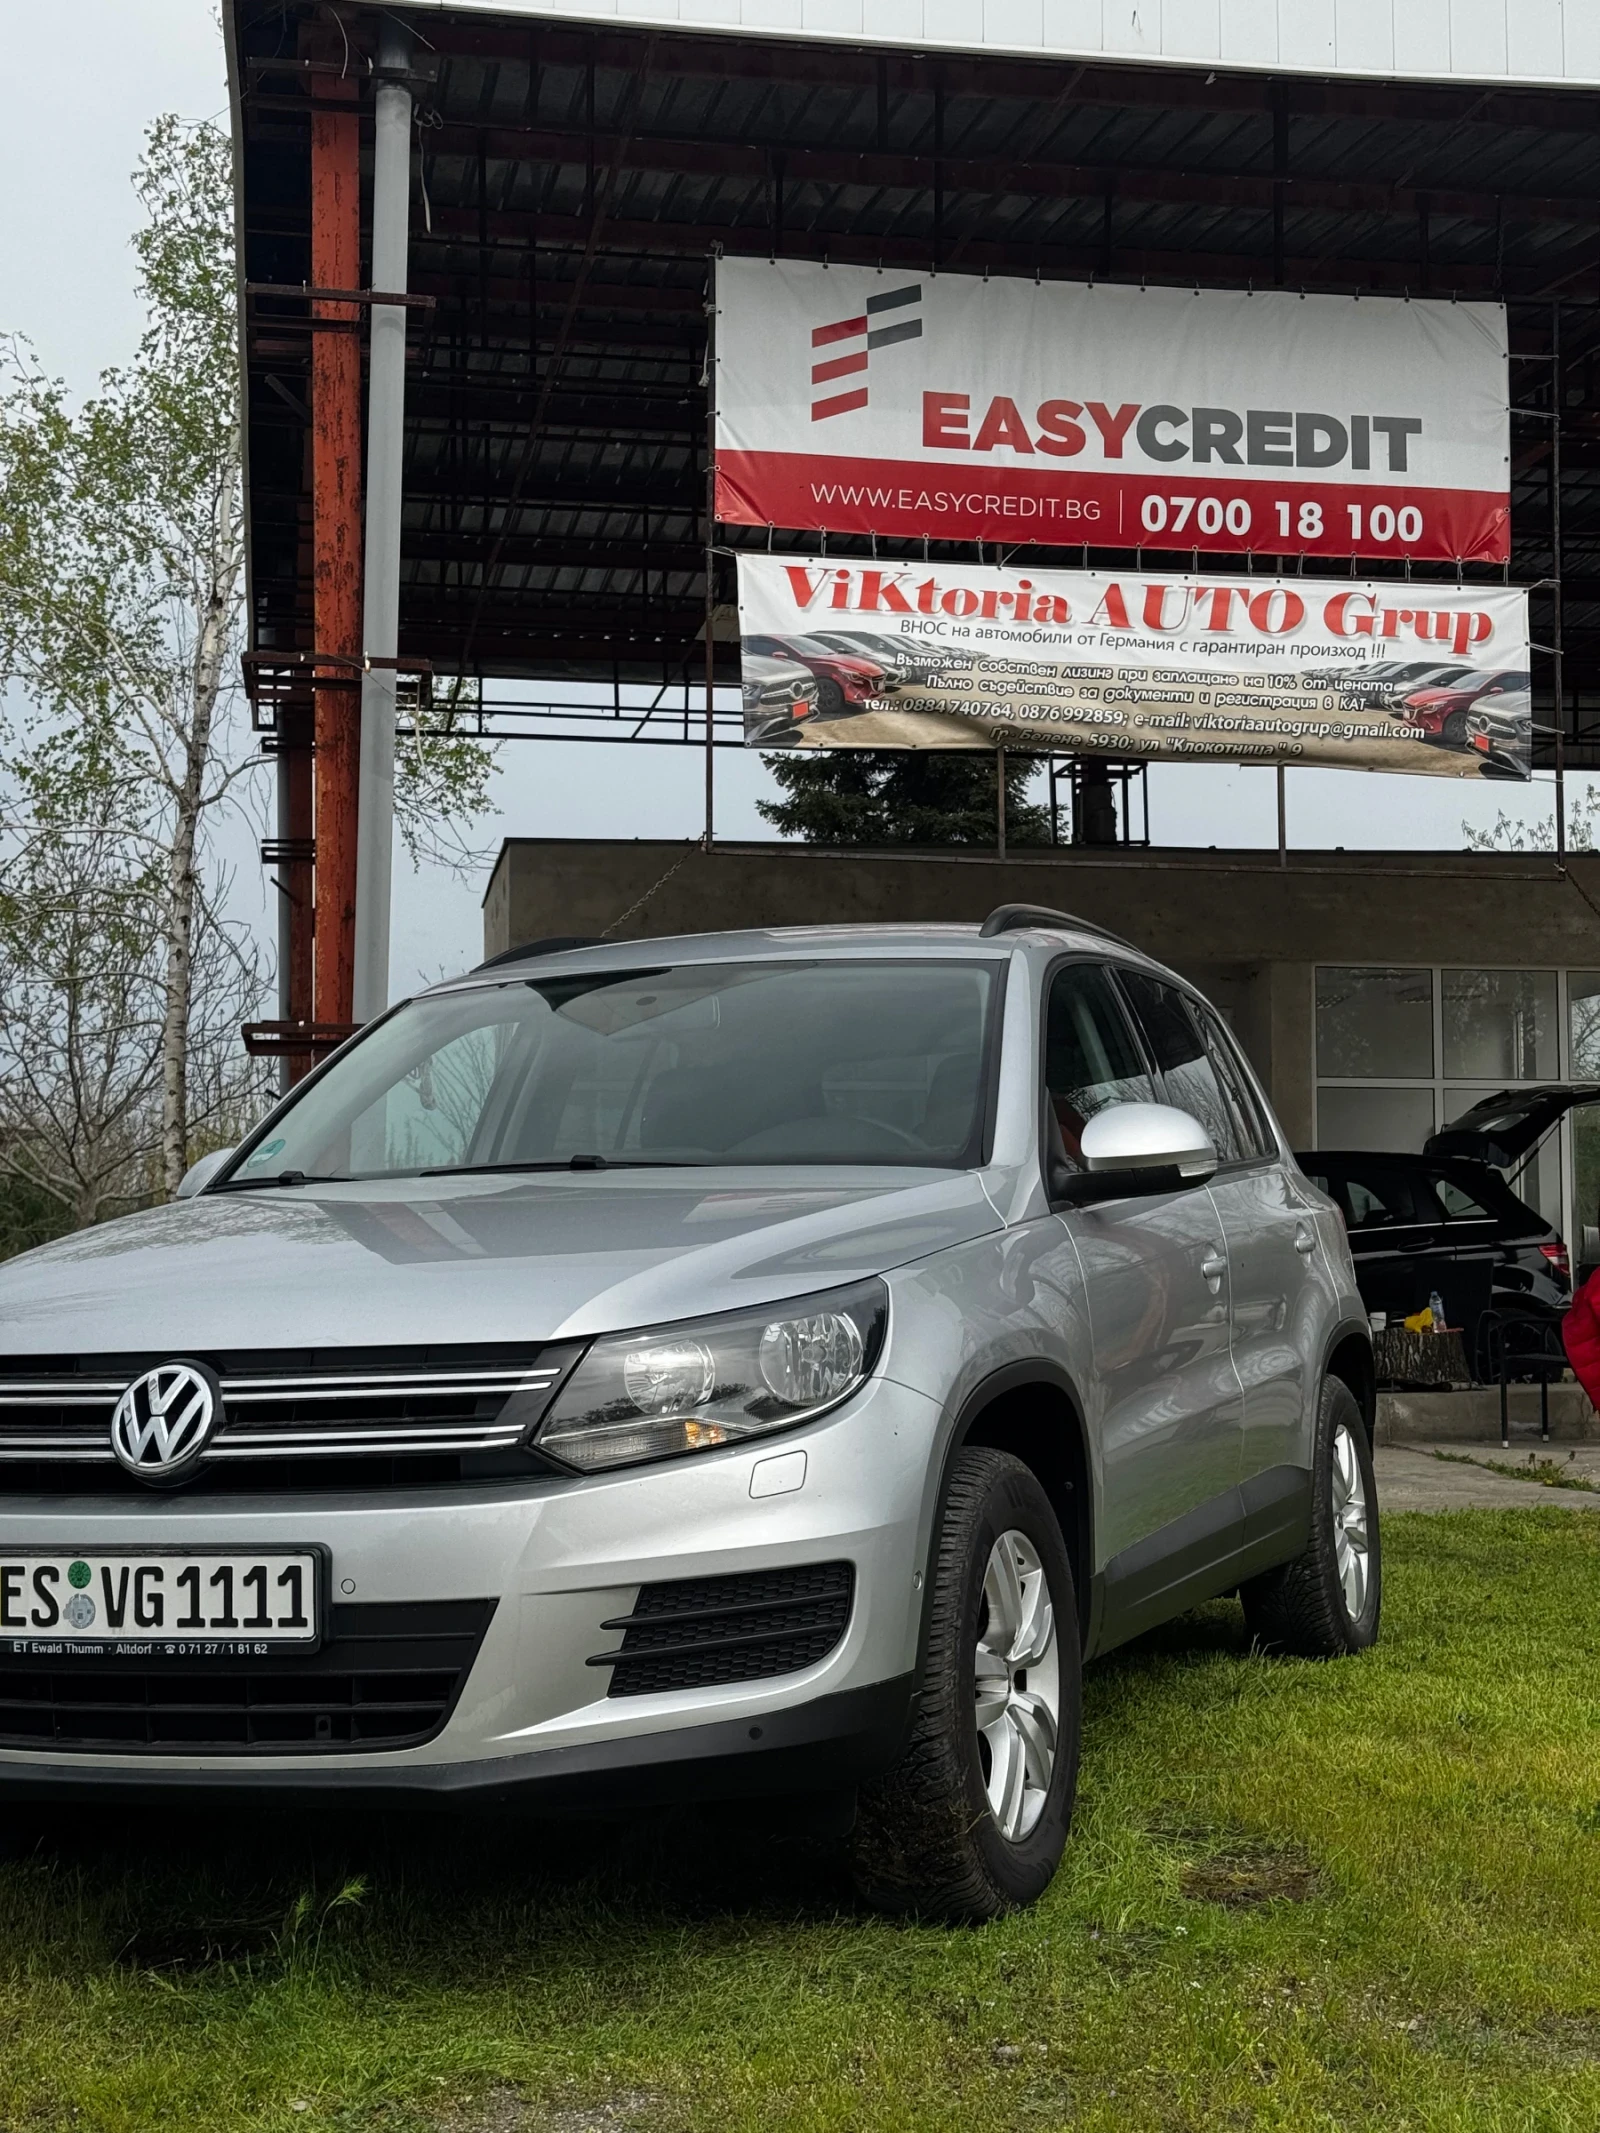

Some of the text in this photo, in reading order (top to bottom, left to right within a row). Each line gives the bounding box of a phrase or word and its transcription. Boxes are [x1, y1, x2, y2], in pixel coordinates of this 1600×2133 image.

[922, 390, 1422, 472] EASYCREDIT
[811, 482, 1101, 522] WWW.EASYCREDIT.BG
[1140, 494, 1424, 543] 0700 18 100
[780, 565, 1493, 656] ViKtoria AUTO Grup
[900, 619, 1386, 661] ВНОС на автомобили от Германия с гарантиран произход !!!
[895, 652, 1395, 694] Възможен собствен лизинг при заплащане на 10% от цената
[925, 674, 1368, 712] Пълно съдействие за документи и регистрация в КАТ
[862, 697, 1426, 740] тел.: 0884 740764, 0876 992859; e-mail: viktoriaautogrup@gmail.com
[1018, 727, 1083, 746] Белене
[1086, 733, 1135, 751] 5930;
[1136, 738, 1161, 753] ул
[1290, 742, 1303, 757] 9
[0, 1565, 60, 1628] ES
[13, 1641, 29, 1653] ET
[31, 1642, 63, 1654] Ewald
[64, 1643, 104, 1654] Thumm
[116, 1643, 152, 1655] Altdorf
